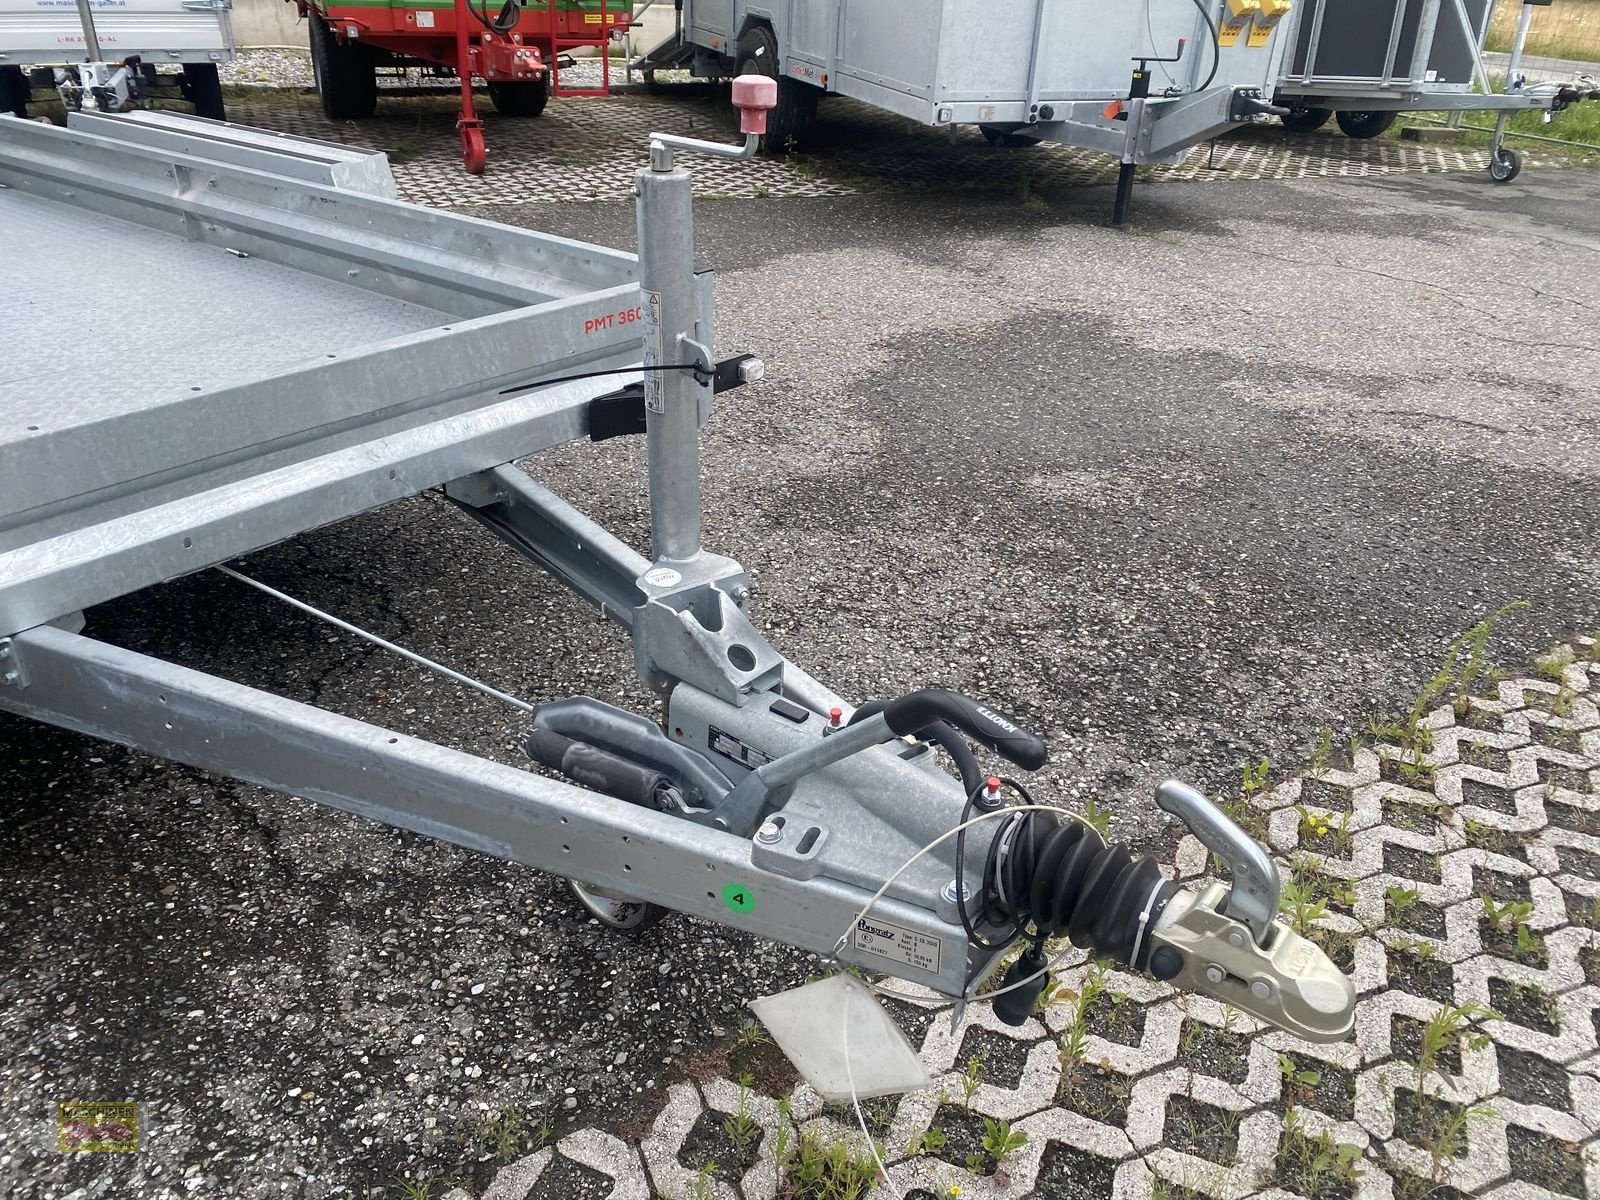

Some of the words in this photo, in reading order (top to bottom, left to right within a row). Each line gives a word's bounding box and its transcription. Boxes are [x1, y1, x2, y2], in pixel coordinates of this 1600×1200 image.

[585, 315, 614, 333] PMT
[981, 708, 1018, 733] KNOTT
[732, 893, 745, 905] 4
[858, 919, 895, 940] Pongratz
